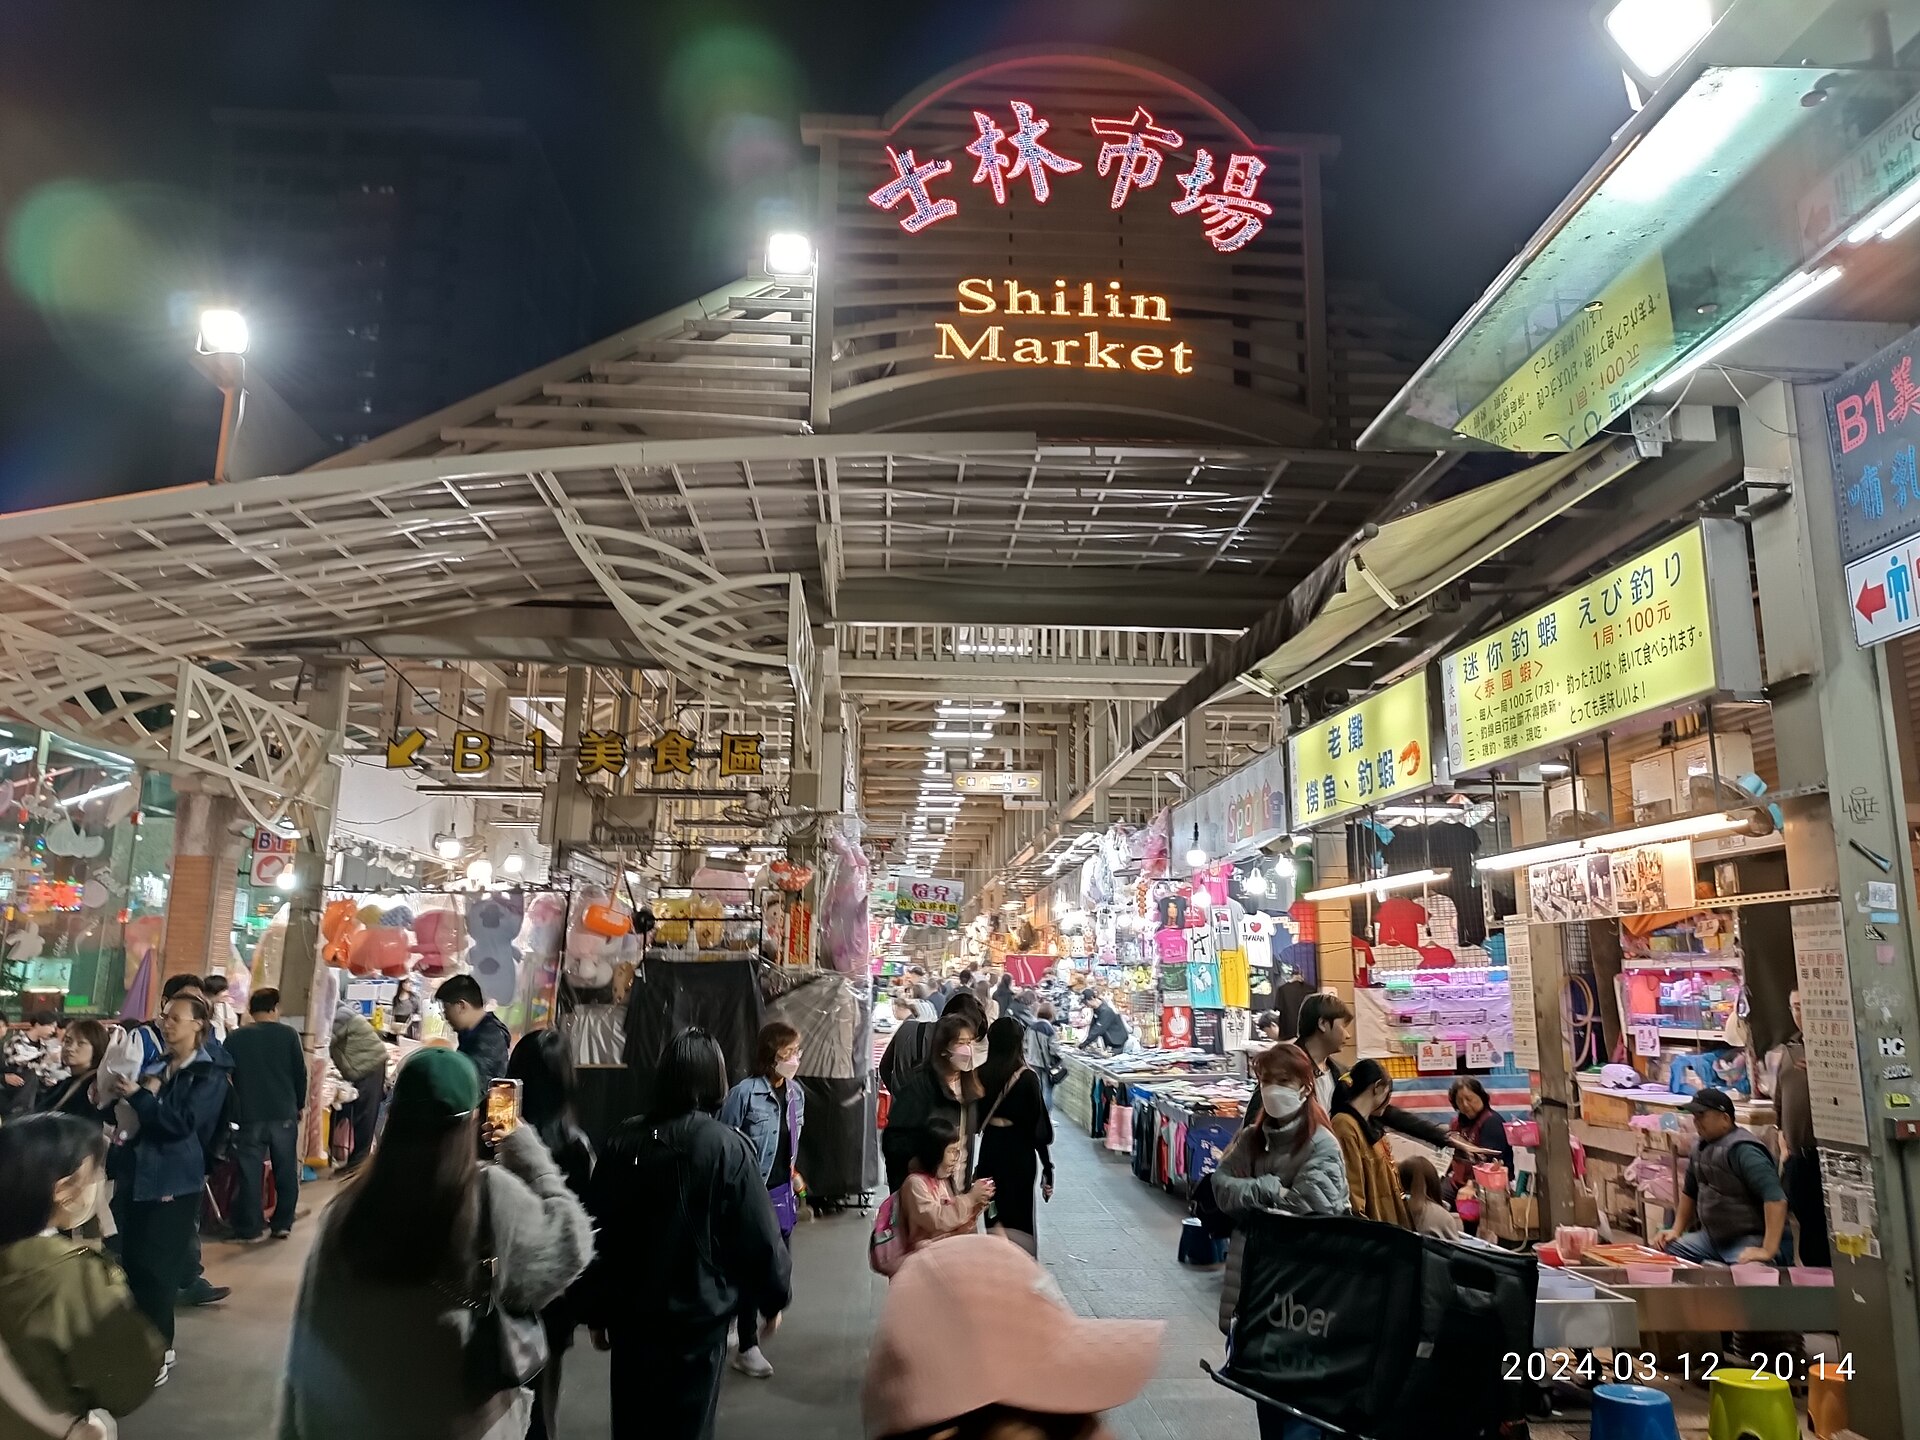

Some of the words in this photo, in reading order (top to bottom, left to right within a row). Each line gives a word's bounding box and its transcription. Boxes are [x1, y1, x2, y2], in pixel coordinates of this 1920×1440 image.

[868, 100, 1273, 252] 士林市場
[957, 278, 1172, 322] Shilin
[934, 323, 1194, 375] Market
[1463, 612, 1558, 683] 迷你釣蝦
[1579, 552, 1681, 629] えび釣り
[453, 729, 763, 777] B1美食區
[1328, 713, 1363, 760] 老攤
[1306, 749, 1395, 814] 撈魚、釣蝦
[1878, 1037, 1905, 1055] HC
[1266, 1291, 1337, 1338] Uber
